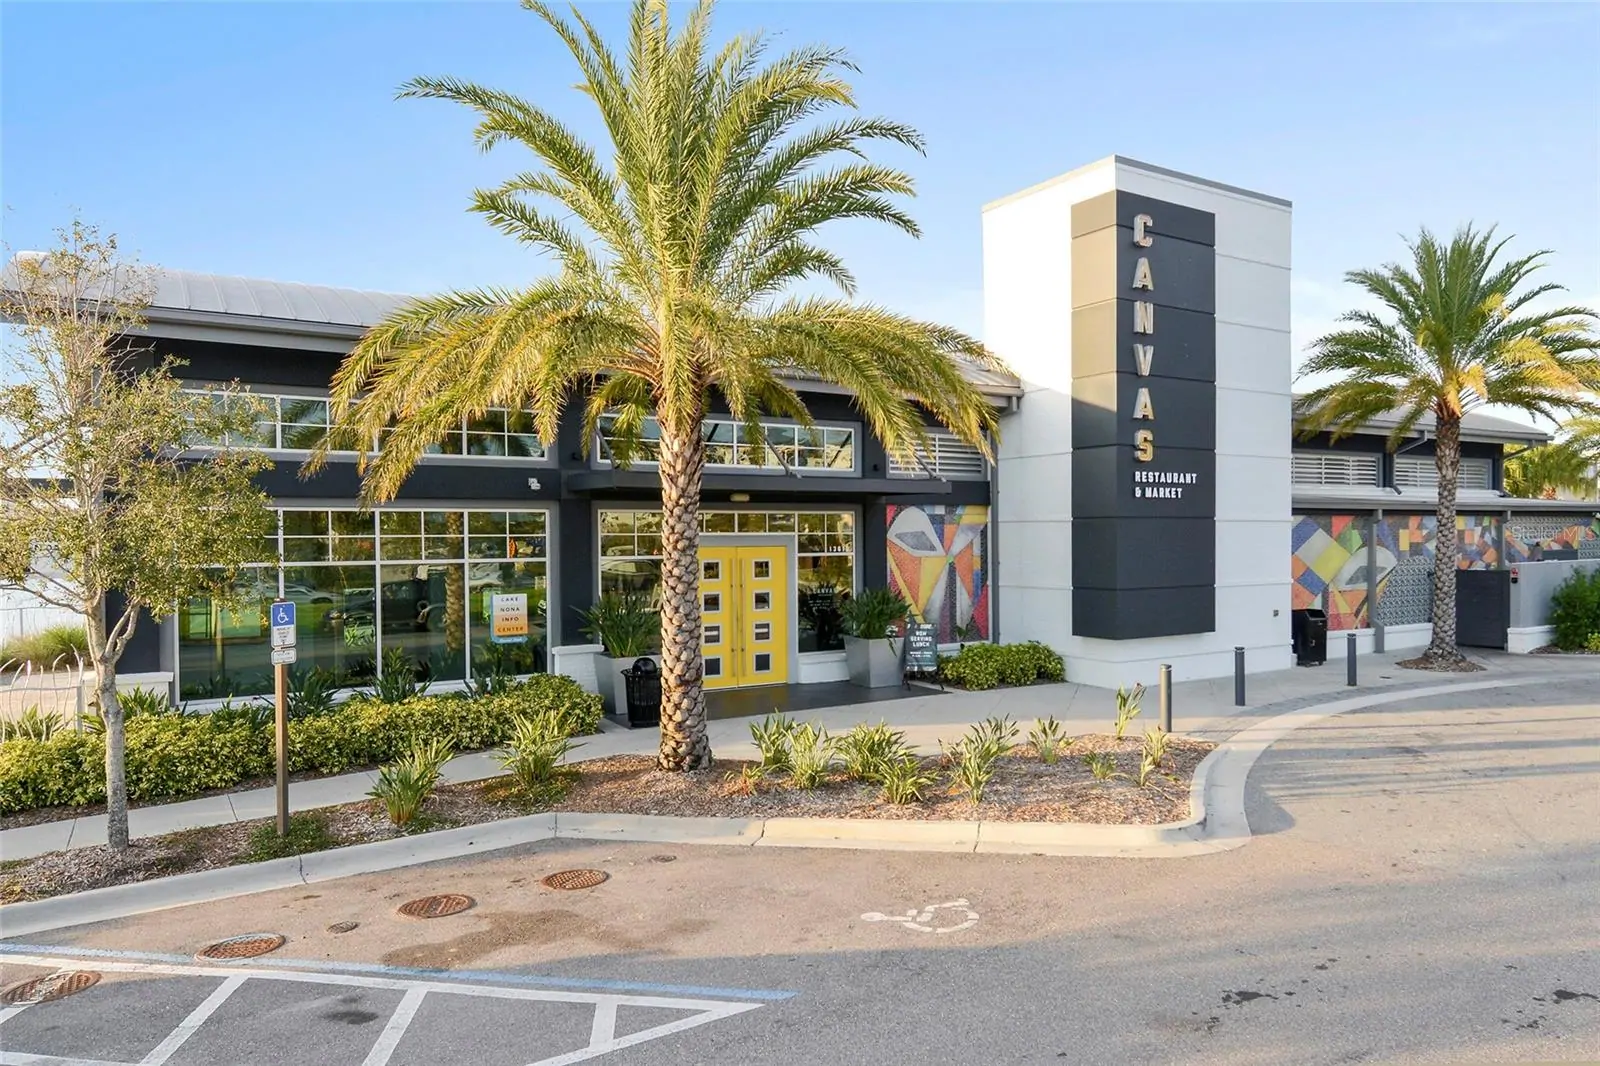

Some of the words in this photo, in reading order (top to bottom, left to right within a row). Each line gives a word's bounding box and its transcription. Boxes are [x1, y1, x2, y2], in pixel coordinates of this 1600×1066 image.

[1133, 213, 1154, 462] CANVAS
[1134, 471, 1197, 484] RESTAURANT
[1135, 486, 1141, 498] &
[1144, 486, 1183, 498] MARKET
